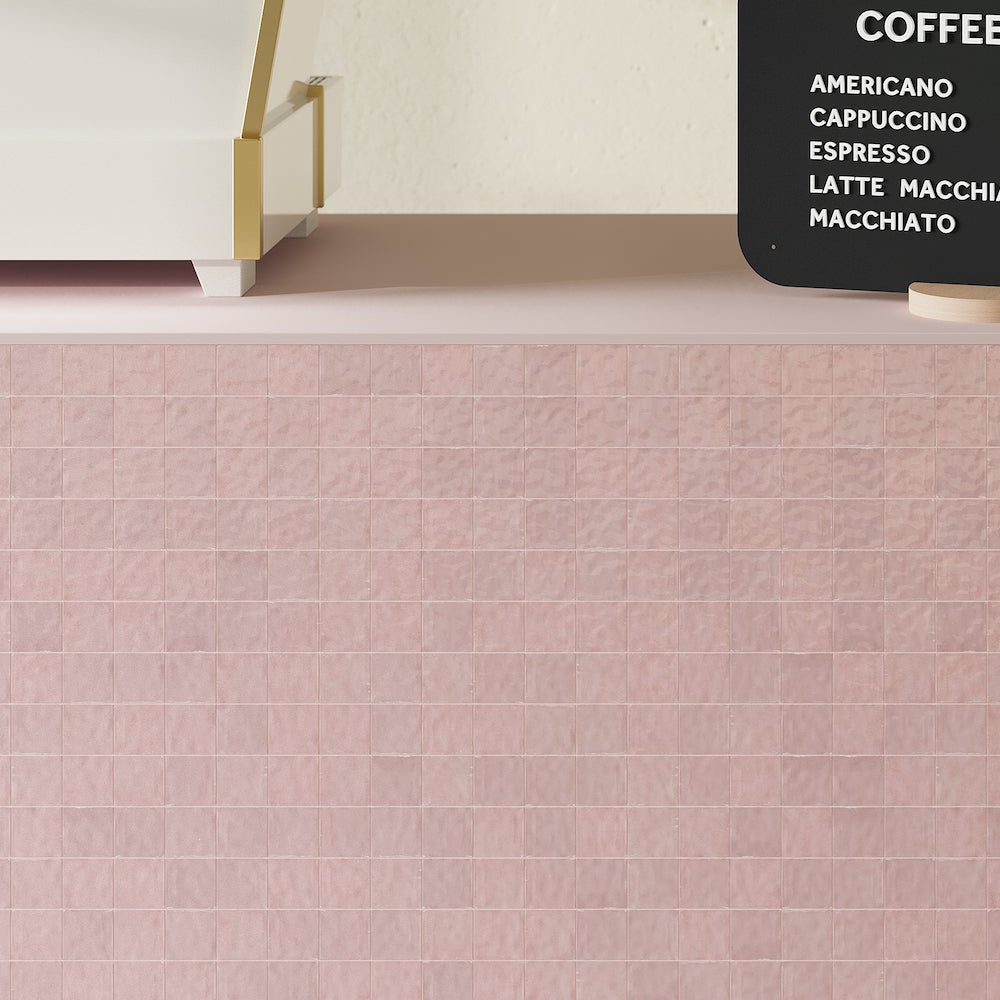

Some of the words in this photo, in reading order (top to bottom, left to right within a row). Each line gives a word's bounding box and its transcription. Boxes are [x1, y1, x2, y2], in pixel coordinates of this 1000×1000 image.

[809, 73, 954, 99] AMERICANO
[809, 107, 967, 133] CAPPUCCINO
[809, 140, 931, 165] ESPRESSO
[809, 174, 885, 197] LATTE
[809, 207, 956, 234] MACCHIATO
